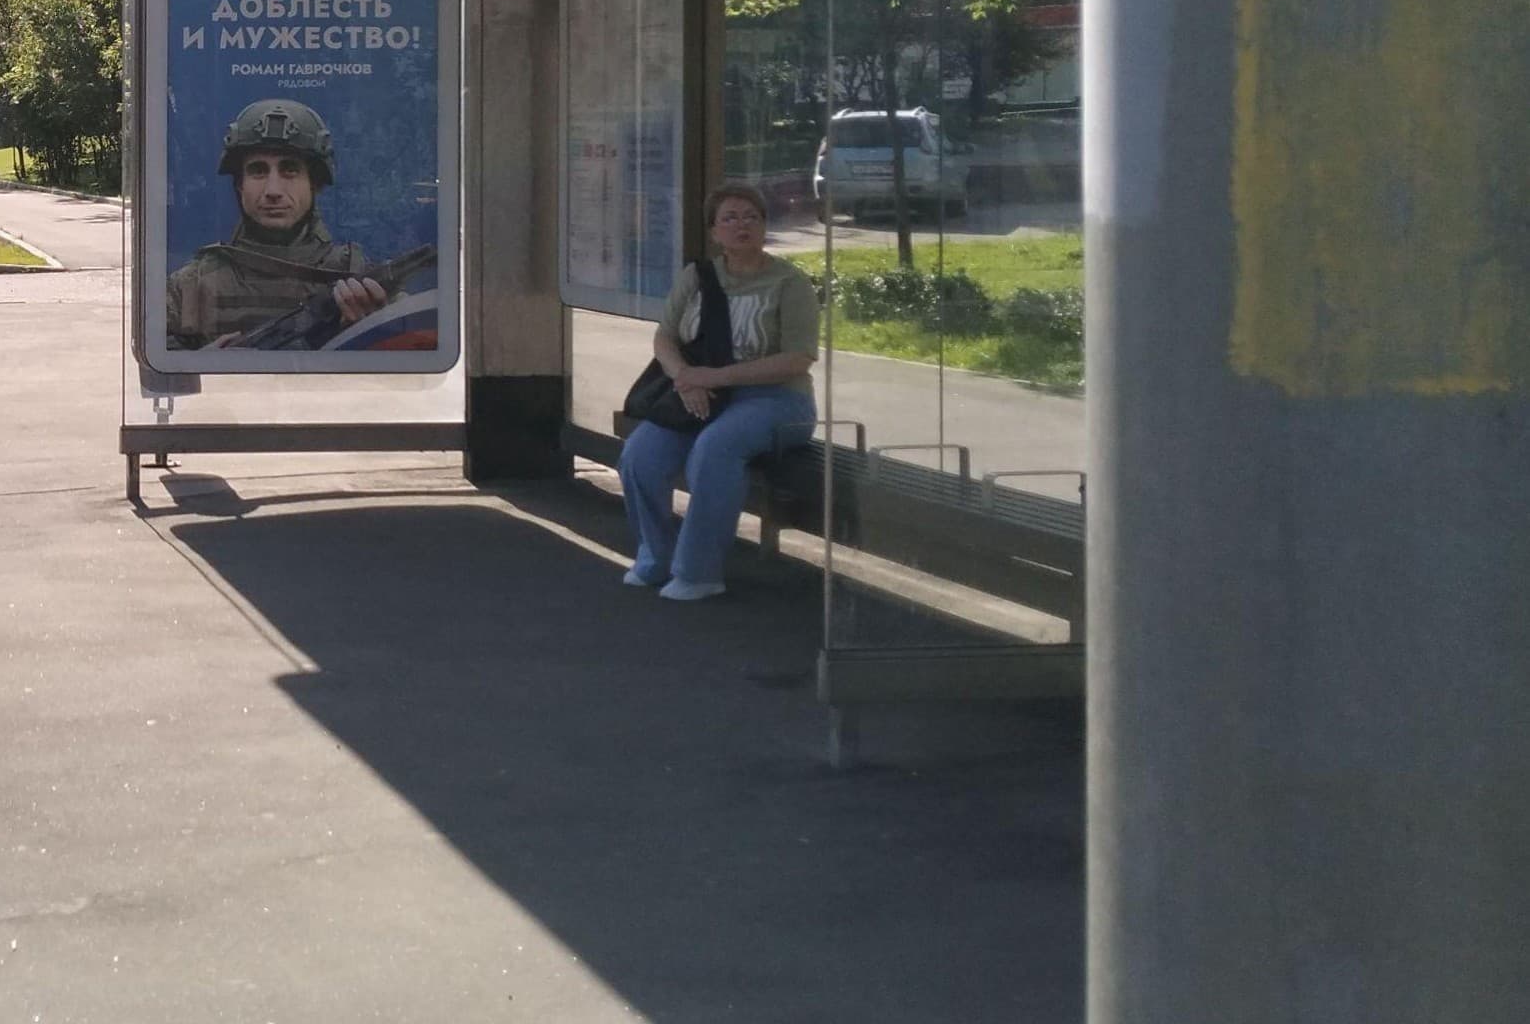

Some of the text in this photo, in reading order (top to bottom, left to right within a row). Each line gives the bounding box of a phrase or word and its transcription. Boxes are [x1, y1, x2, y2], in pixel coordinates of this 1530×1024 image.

[182, 27, 420, 49] И МУЖЕСТВО!
[231, 64, 284, 75] РОМАН
